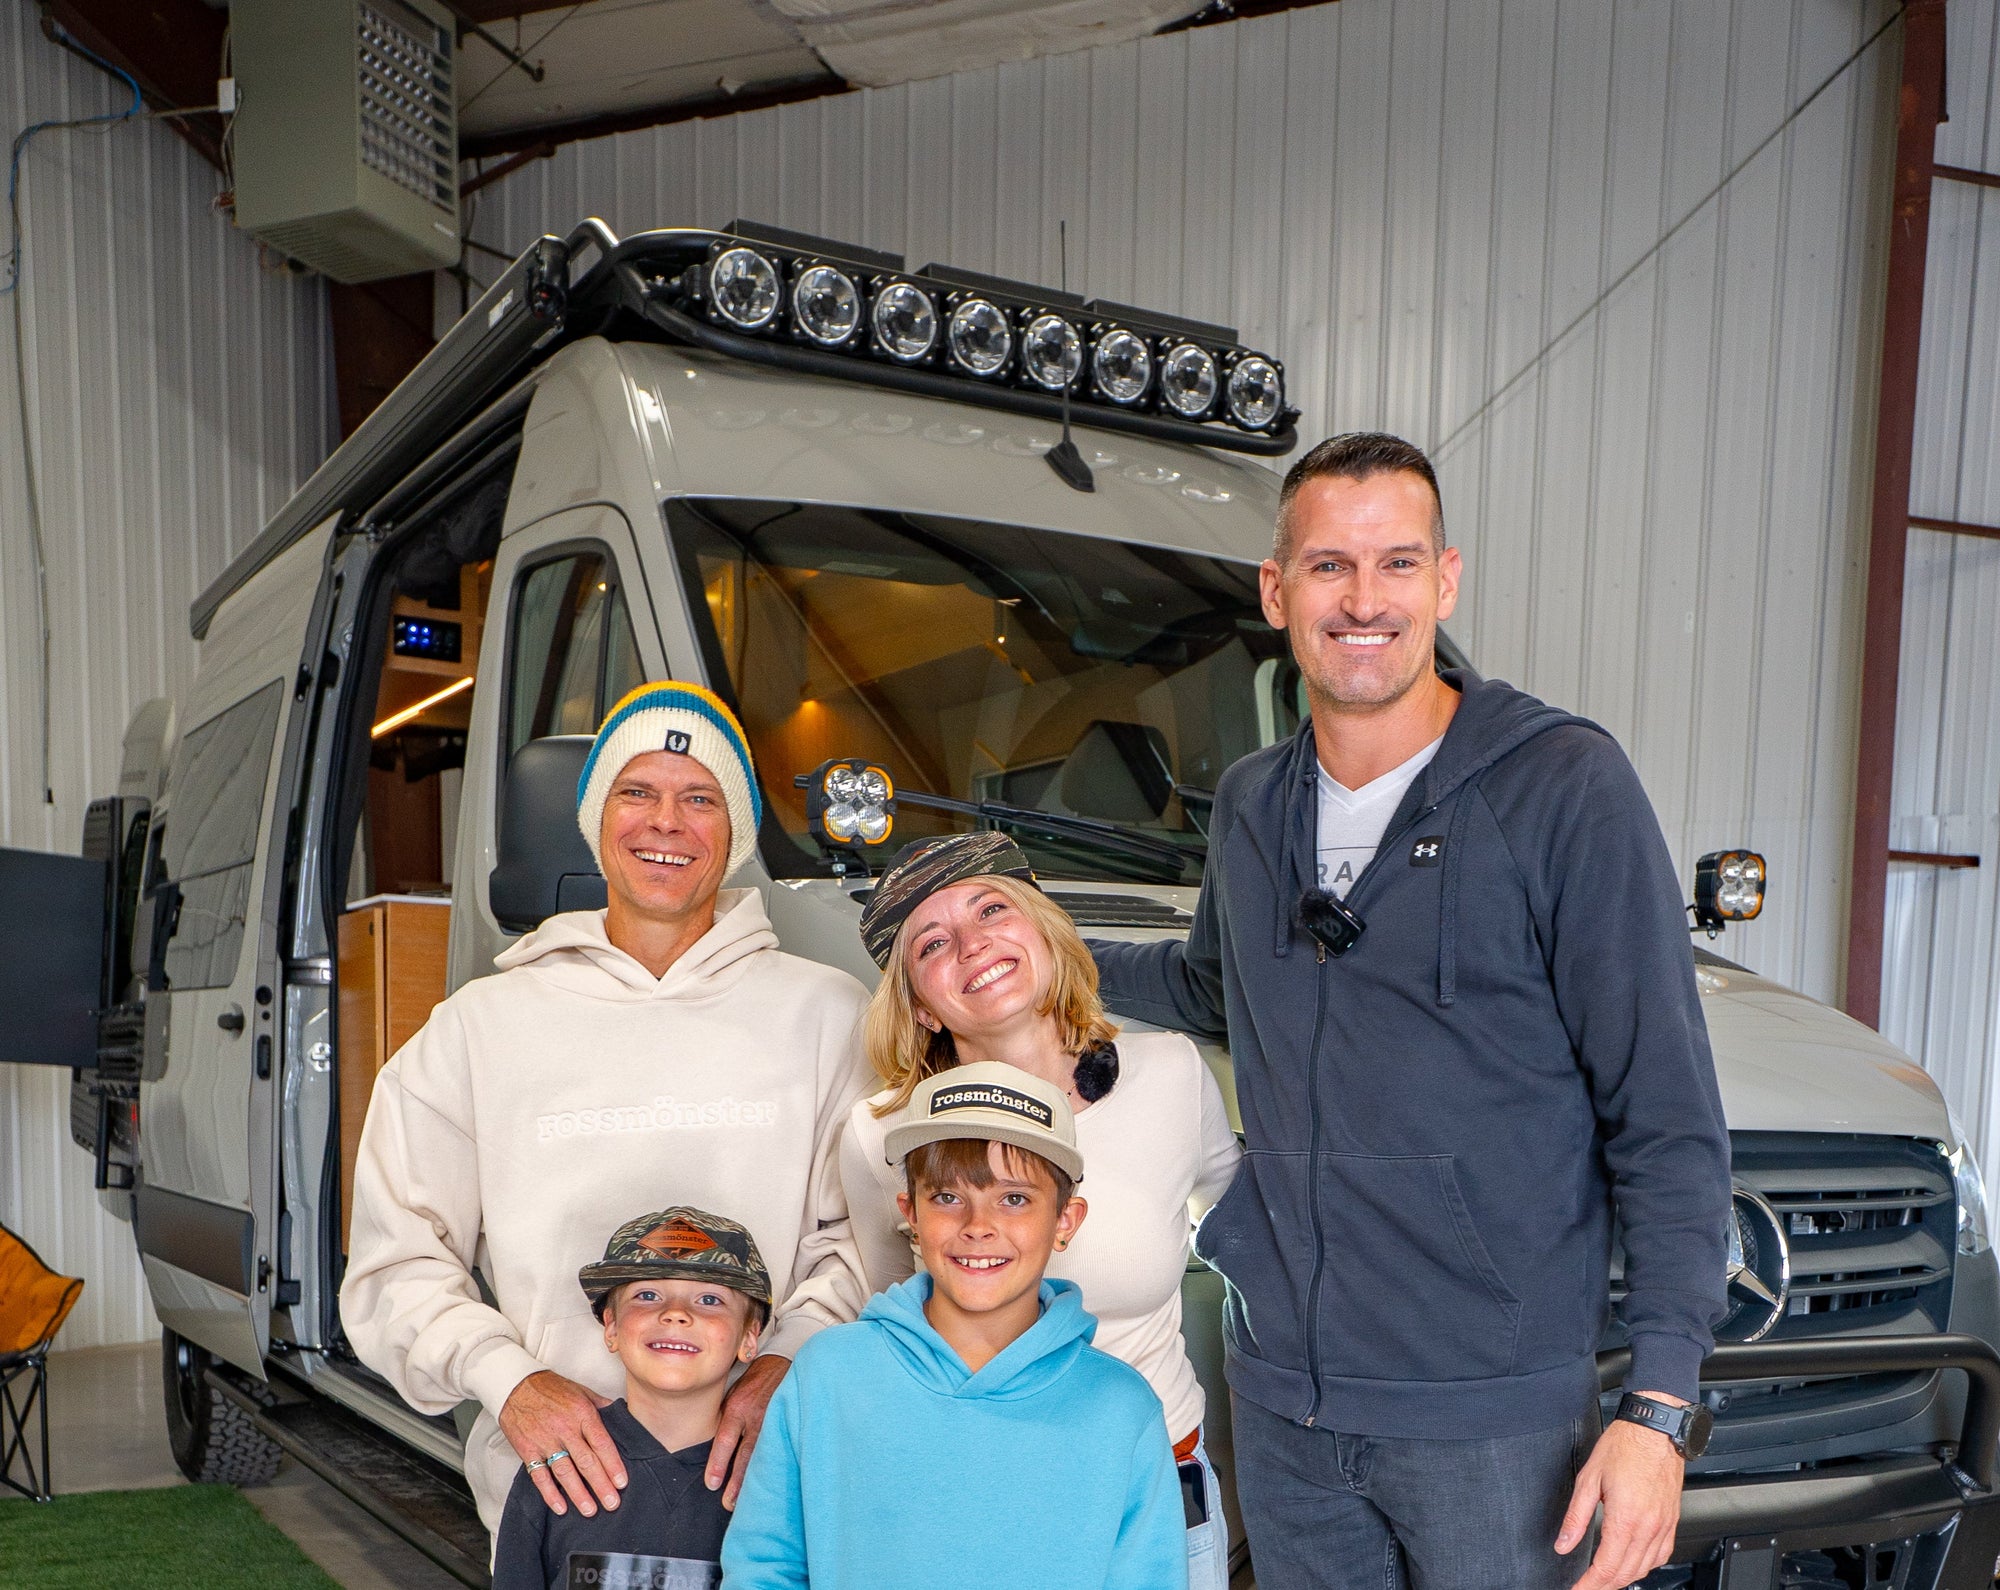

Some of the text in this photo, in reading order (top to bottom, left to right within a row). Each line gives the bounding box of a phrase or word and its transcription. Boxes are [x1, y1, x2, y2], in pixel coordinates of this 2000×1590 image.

[1317, 860, 1369, 885] RA
[537, 1095, 777, 1139] rossmönster
[934, 1088, 1049, 1120] rossmönster
